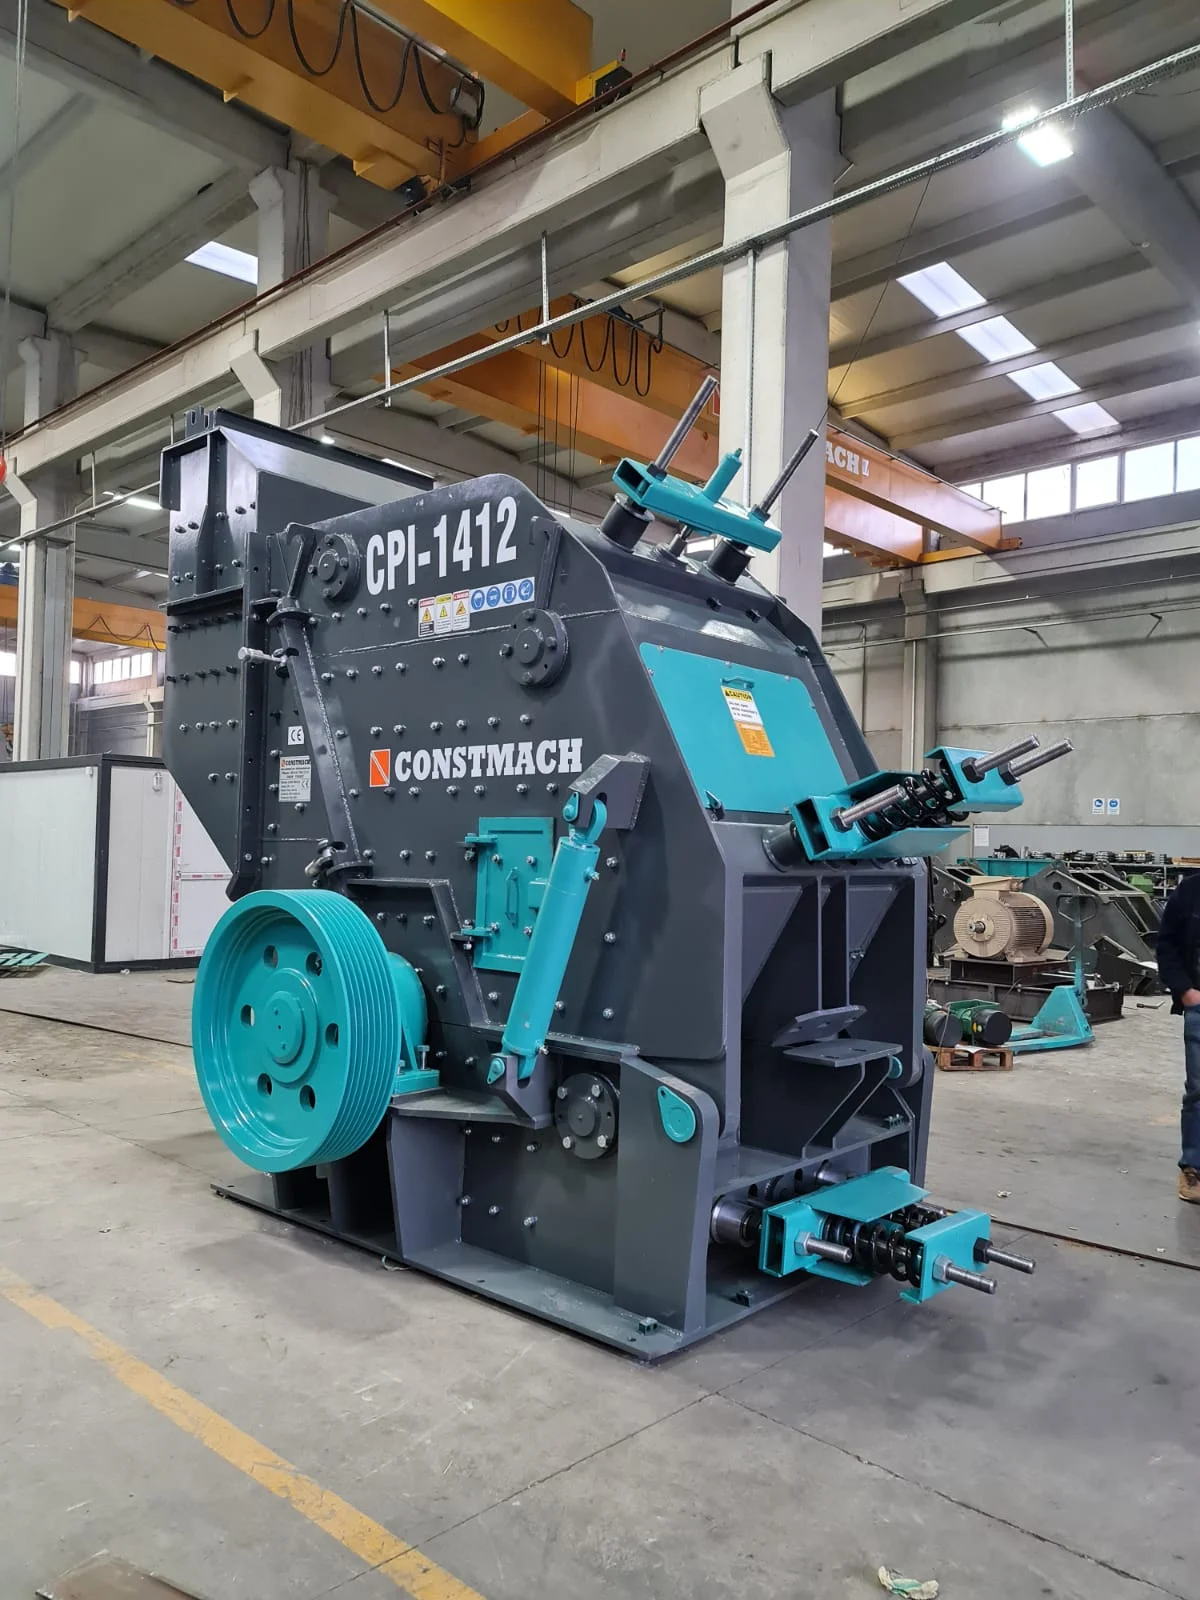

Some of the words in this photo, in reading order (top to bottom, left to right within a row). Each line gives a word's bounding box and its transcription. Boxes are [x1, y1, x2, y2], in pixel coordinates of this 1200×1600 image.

[366, 496, 517, 596] CPI-1412
[290, 729, 302, 742] CE
[394, 738, 583, 782] CONSTMACH
